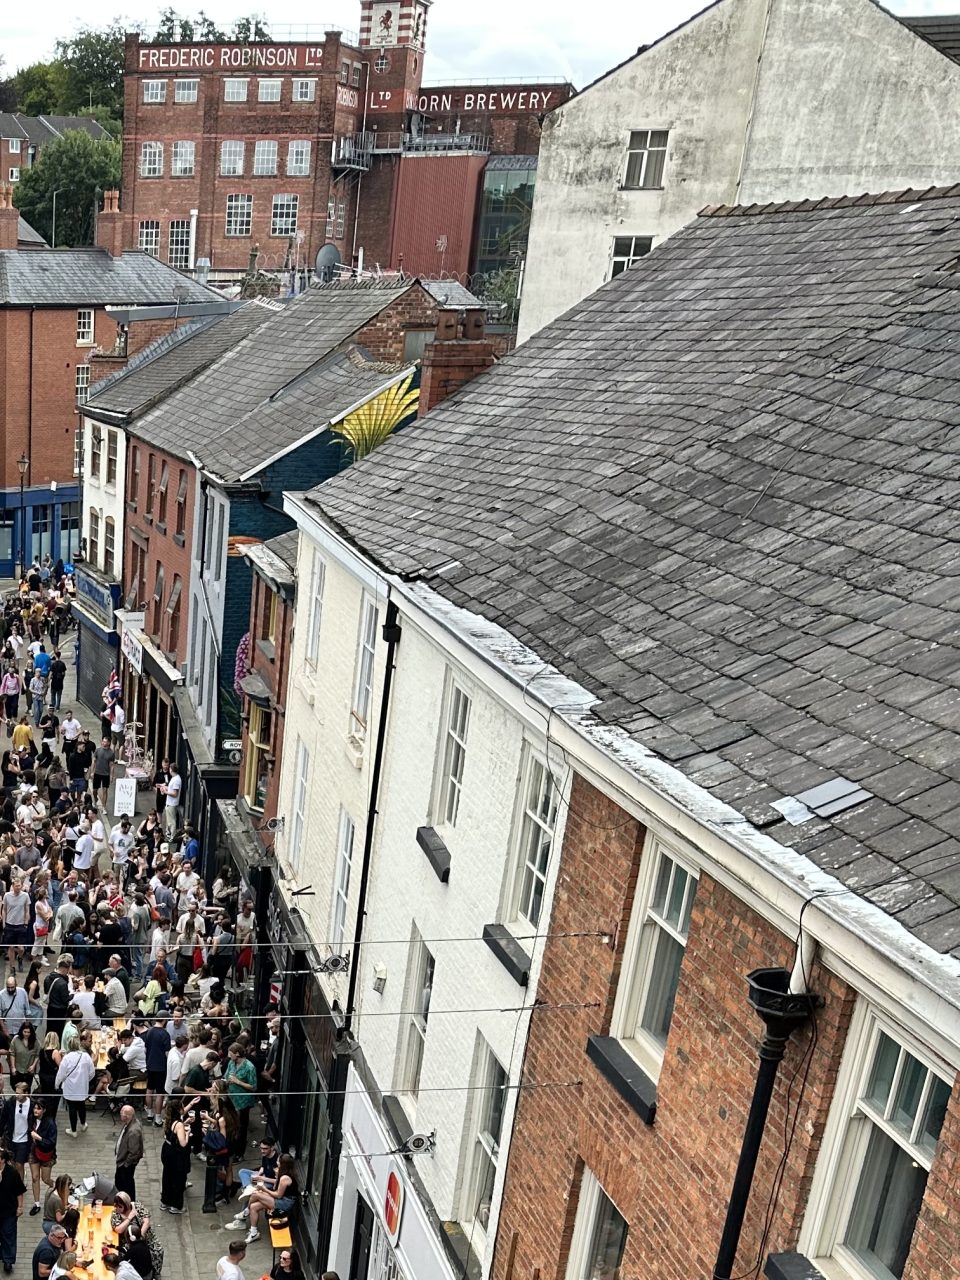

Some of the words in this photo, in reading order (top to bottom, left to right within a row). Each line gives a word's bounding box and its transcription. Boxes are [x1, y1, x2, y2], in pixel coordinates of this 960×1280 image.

[139, 49, 215, 67] FREDERIC
[220, 48, 298, 66] ROBINSON
[464, 91, 553, 110] BREWERY
